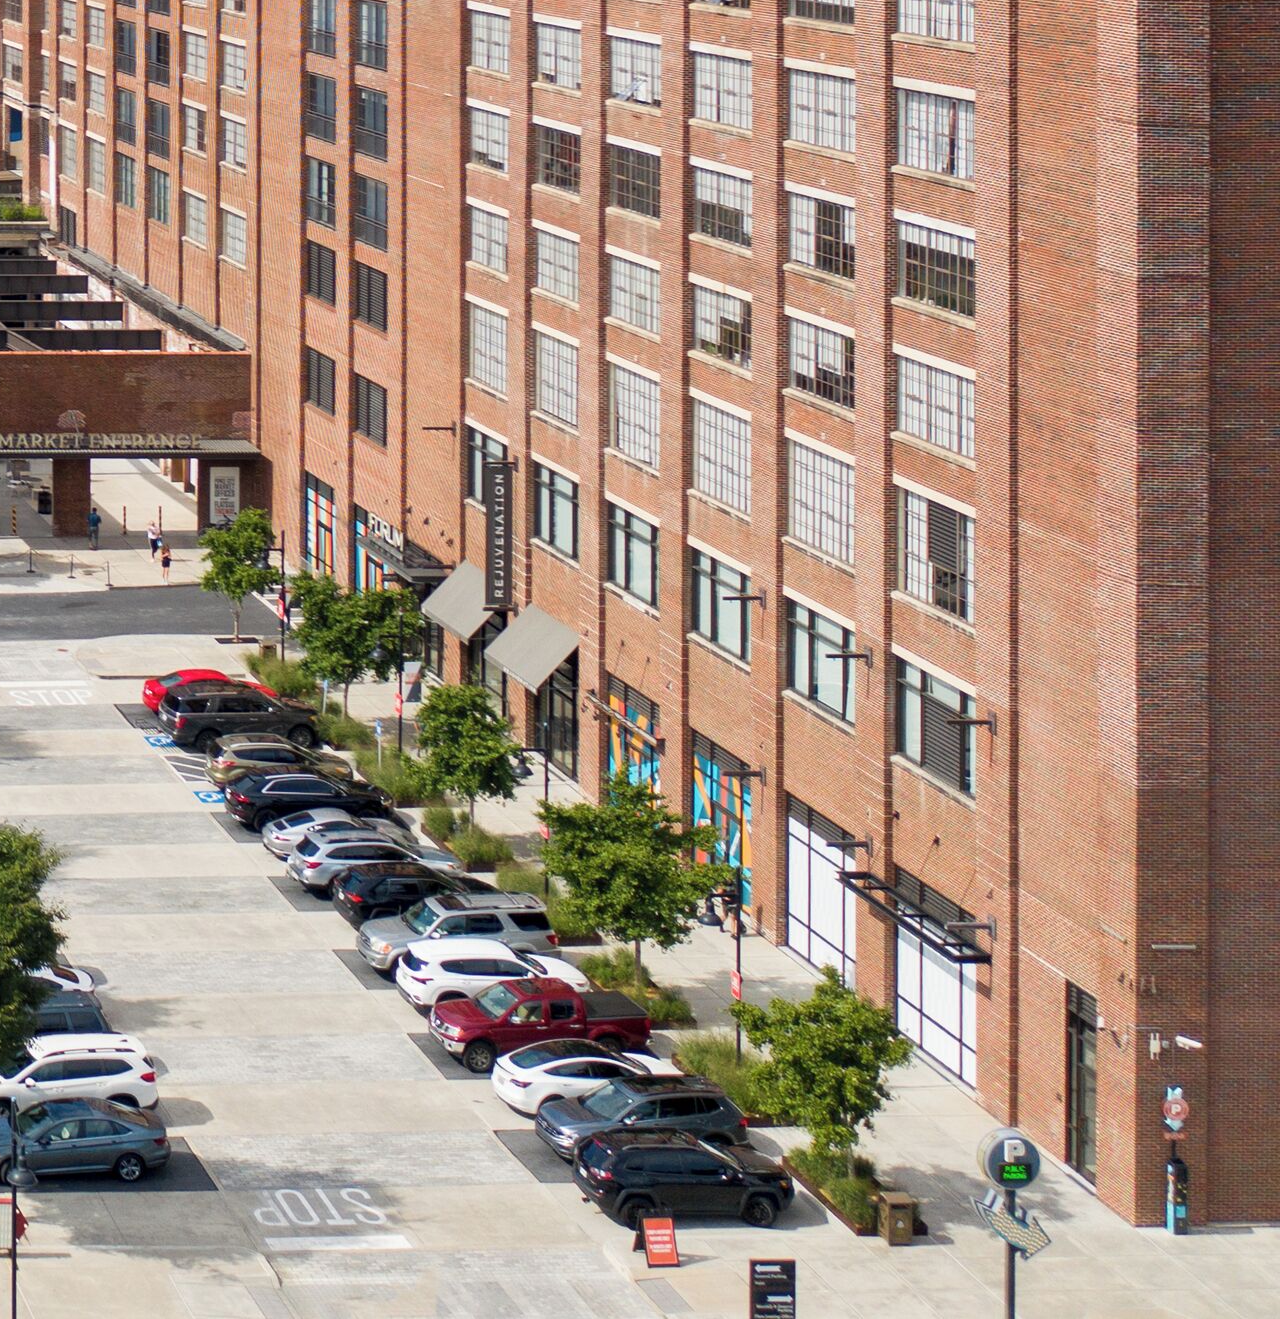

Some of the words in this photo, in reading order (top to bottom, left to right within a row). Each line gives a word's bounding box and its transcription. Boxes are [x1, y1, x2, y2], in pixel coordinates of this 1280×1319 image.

[89, 433, 202, 450] ENTRANCE
[368, 511, 404, 553] FORUM
[493, 474, 505, 598] REJUVENATION
[1171, 1104, 1182, 1116] P
[1004, 1140, 1026, 1163] P
[253, 1187, 388, 1226] STOP
